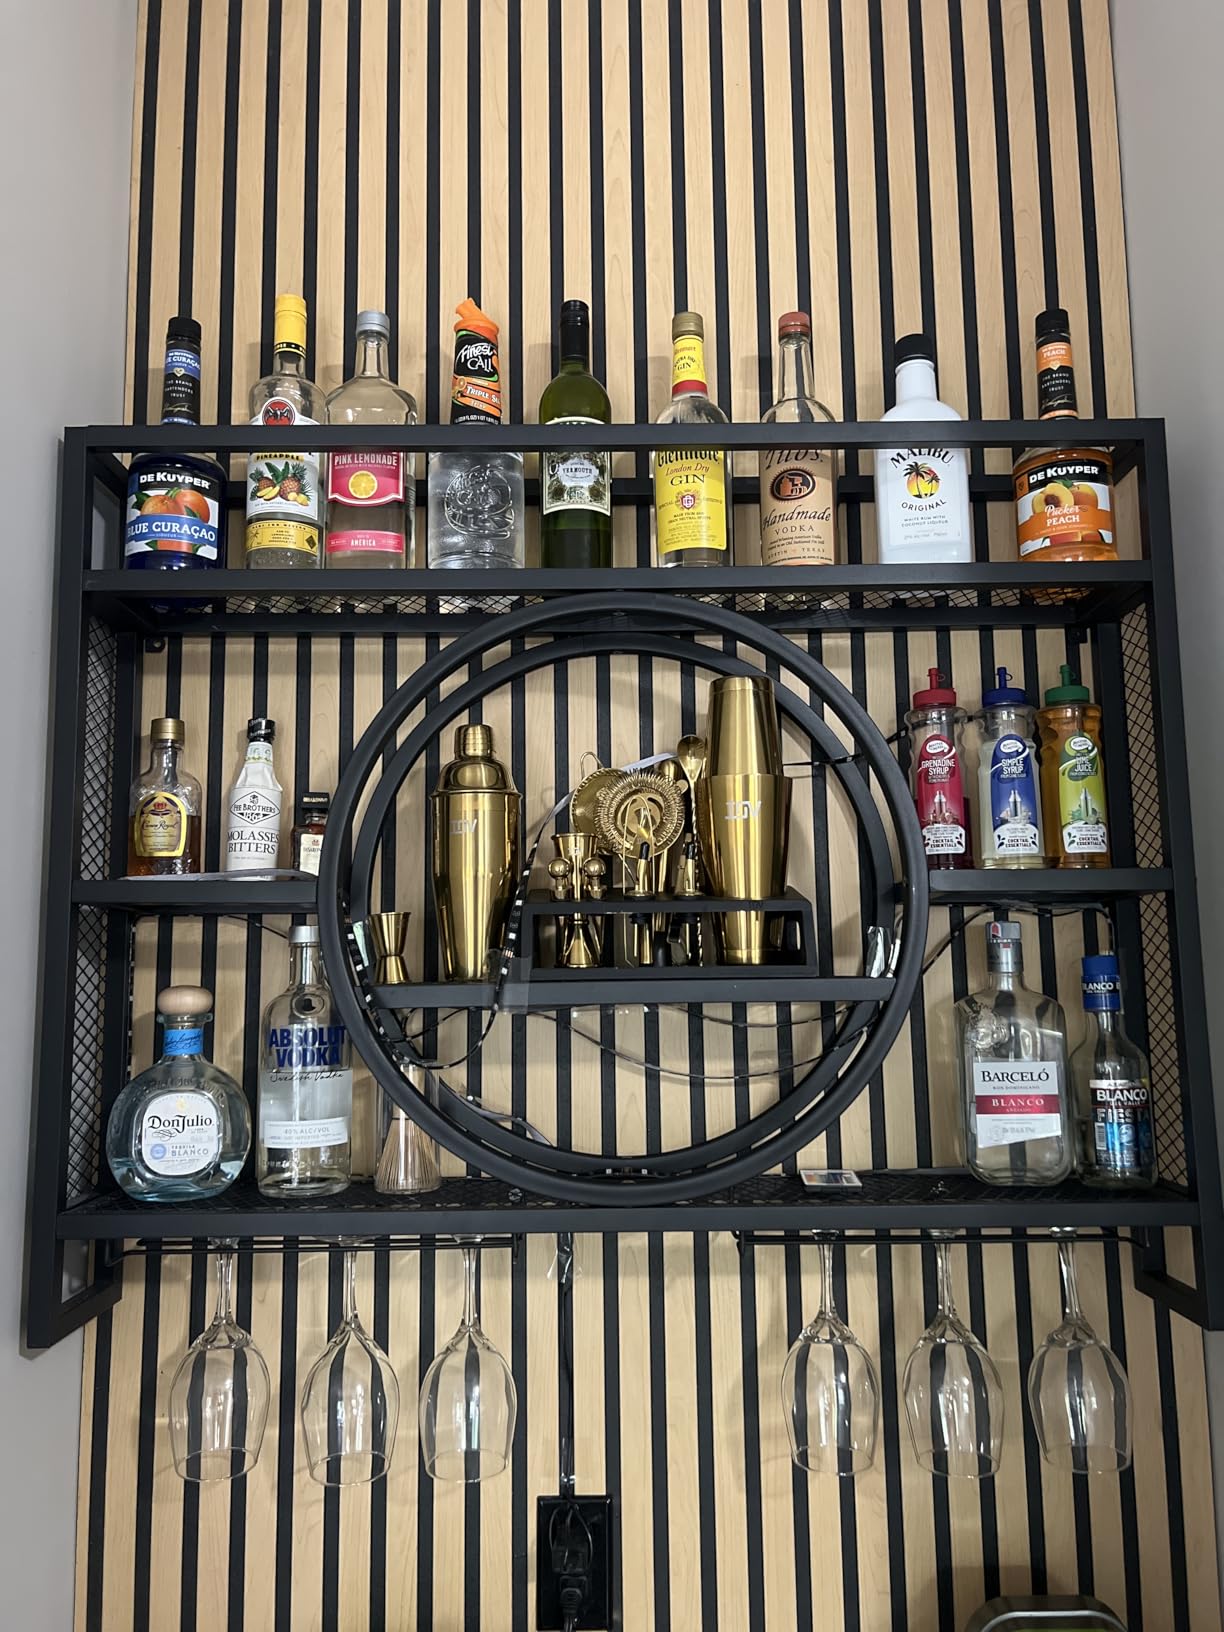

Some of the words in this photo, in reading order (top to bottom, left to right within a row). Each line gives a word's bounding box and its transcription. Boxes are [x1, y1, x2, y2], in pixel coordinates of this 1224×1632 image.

[458, 342, 493, 362] Finest
[677, 362, 691, 370] GIN
[466, 385, 490, 399] TRIPLE
[256, 453, 300, 461] PINEAPPLE
[334, 453, 353, 466] PINK
[354, 453, 398, 466] LEMONADE
[890, 448, 954, 468] MALIBU
[666, 464, 692, 476] London
[694, 463, 710, 473] Dry
[1029, 471, 1045, 484] DE
[1046, 465, 1099, 478] KUYPER
[139, 473, 155, 483] DE
[156, 472, 210, 489] KUYPER
[670, 474, 705, 486] GIN
[901, 499, 947, 511] ORIGINAL
[1044, 504, 1080, 518] Pucker
[762, 504, 831, 531] Handmade
[1046, 514, 1080, 527] PEACH
[127, 523, 149, 537] BLUE
[152, 521, 215, 541] CURAÇAO
[775, 524, 815, 535] VODKA
[351, 538, 376, 547] AMERICA
[921, 758, 956, 769] GRENADINE
[1001, 758, 1024, 767] SIMPLE
[1075, 756, 1089, 764] LIME
[928, 766, 949, 775] SYRUP
[1002, 765, 1024, 775] SYRUP
[1074, 763, 1092, 772] JUICE
[243, 803, 276, 814] BROTHERS
[227, 830, 280, 844] MOLASSES
[228, 842, 276, 855] BITTERS
[269, 1025, 345, 1048] ABSOLUT
[276, 1046, 340, 1068] VODKA
[270, 1072, 311, 1082] Swedish
[315, 1069, 344, 1081] Vodka
[981, 1067, 1049, 1084] BARCELÓ
[1096, 1088, 1147, 1102] BLANCO
[992, 1098, 1045, 1107] BLANCO
[147, 1115, 180, 1129] Don
[174, 1114, 213, 1134] Julio
[300, 1126, 330, 1134] ALC/VOL
[171, 1148, 209, 1156] BLANCO
